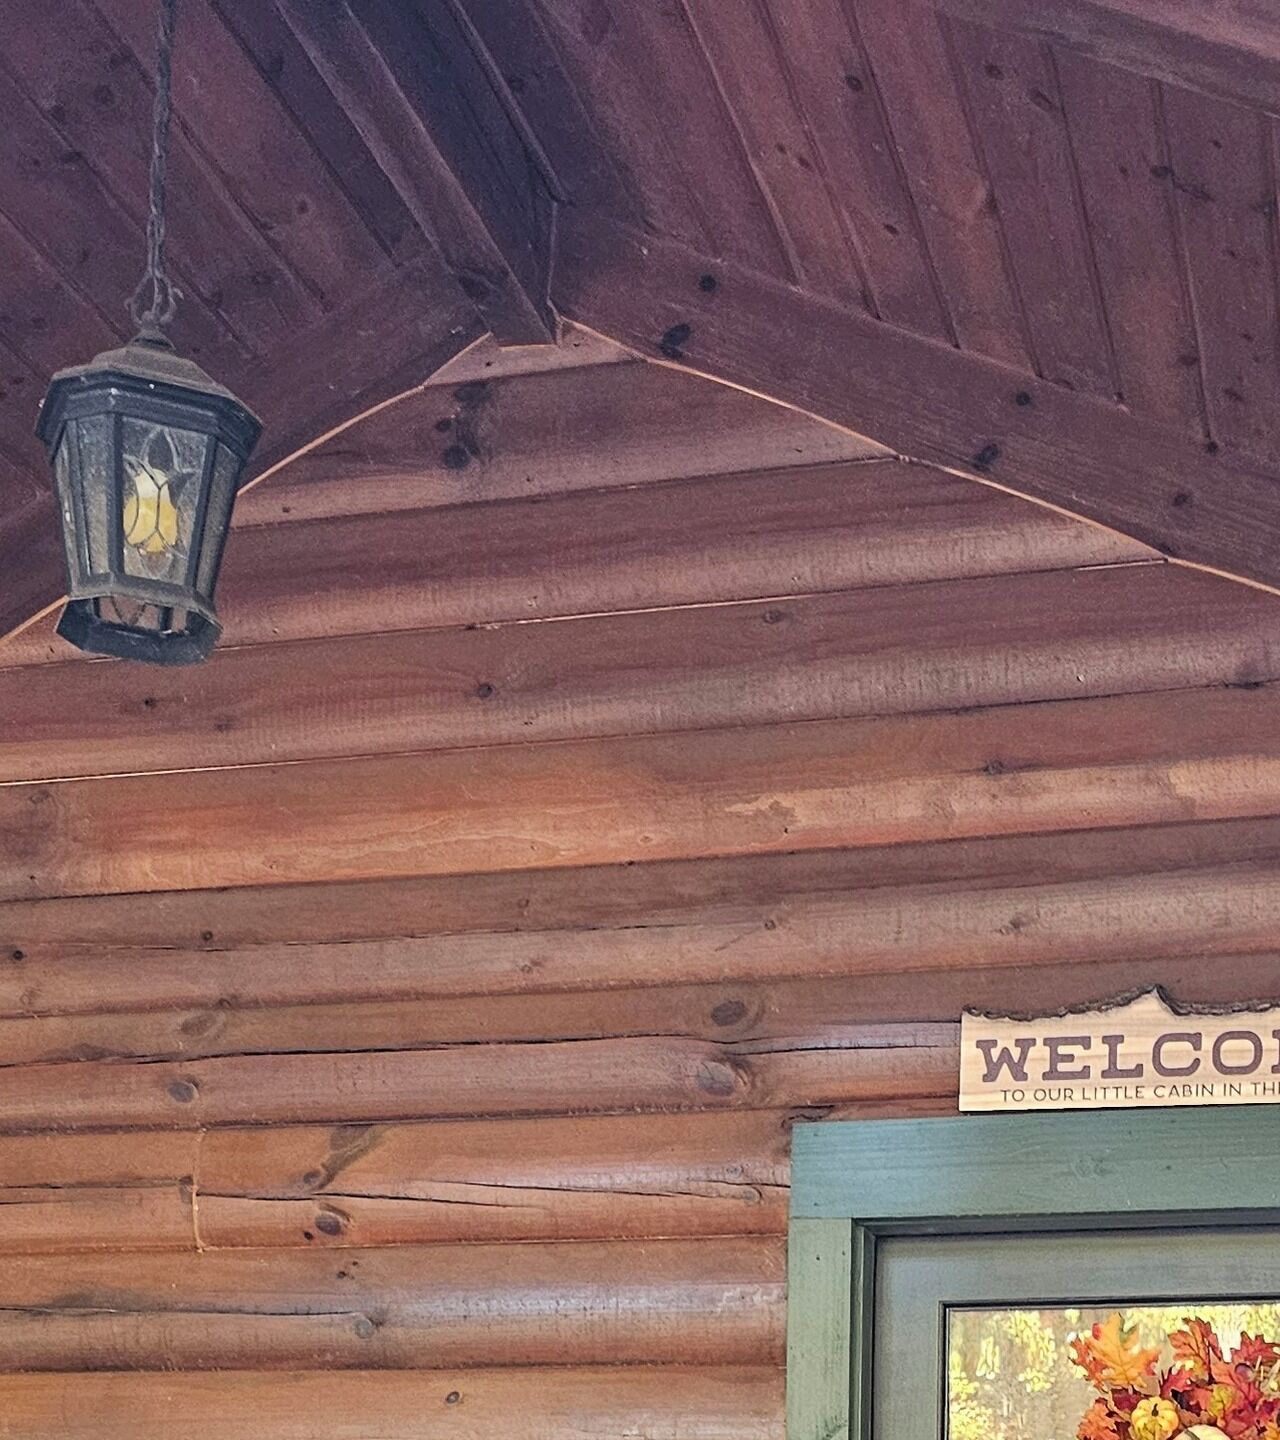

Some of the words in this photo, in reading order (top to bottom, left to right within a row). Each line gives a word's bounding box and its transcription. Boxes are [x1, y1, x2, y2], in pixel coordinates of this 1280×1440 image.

[999, 1088, 1026, 1103] TO
[1032, 1087, 1075, 1102] OUR
[1081, 1085, 1146, 1101] LITTLE
[1152, 1083, 1215, 1099] CABIN
[1222, 1082, 1242, 1097] IN
